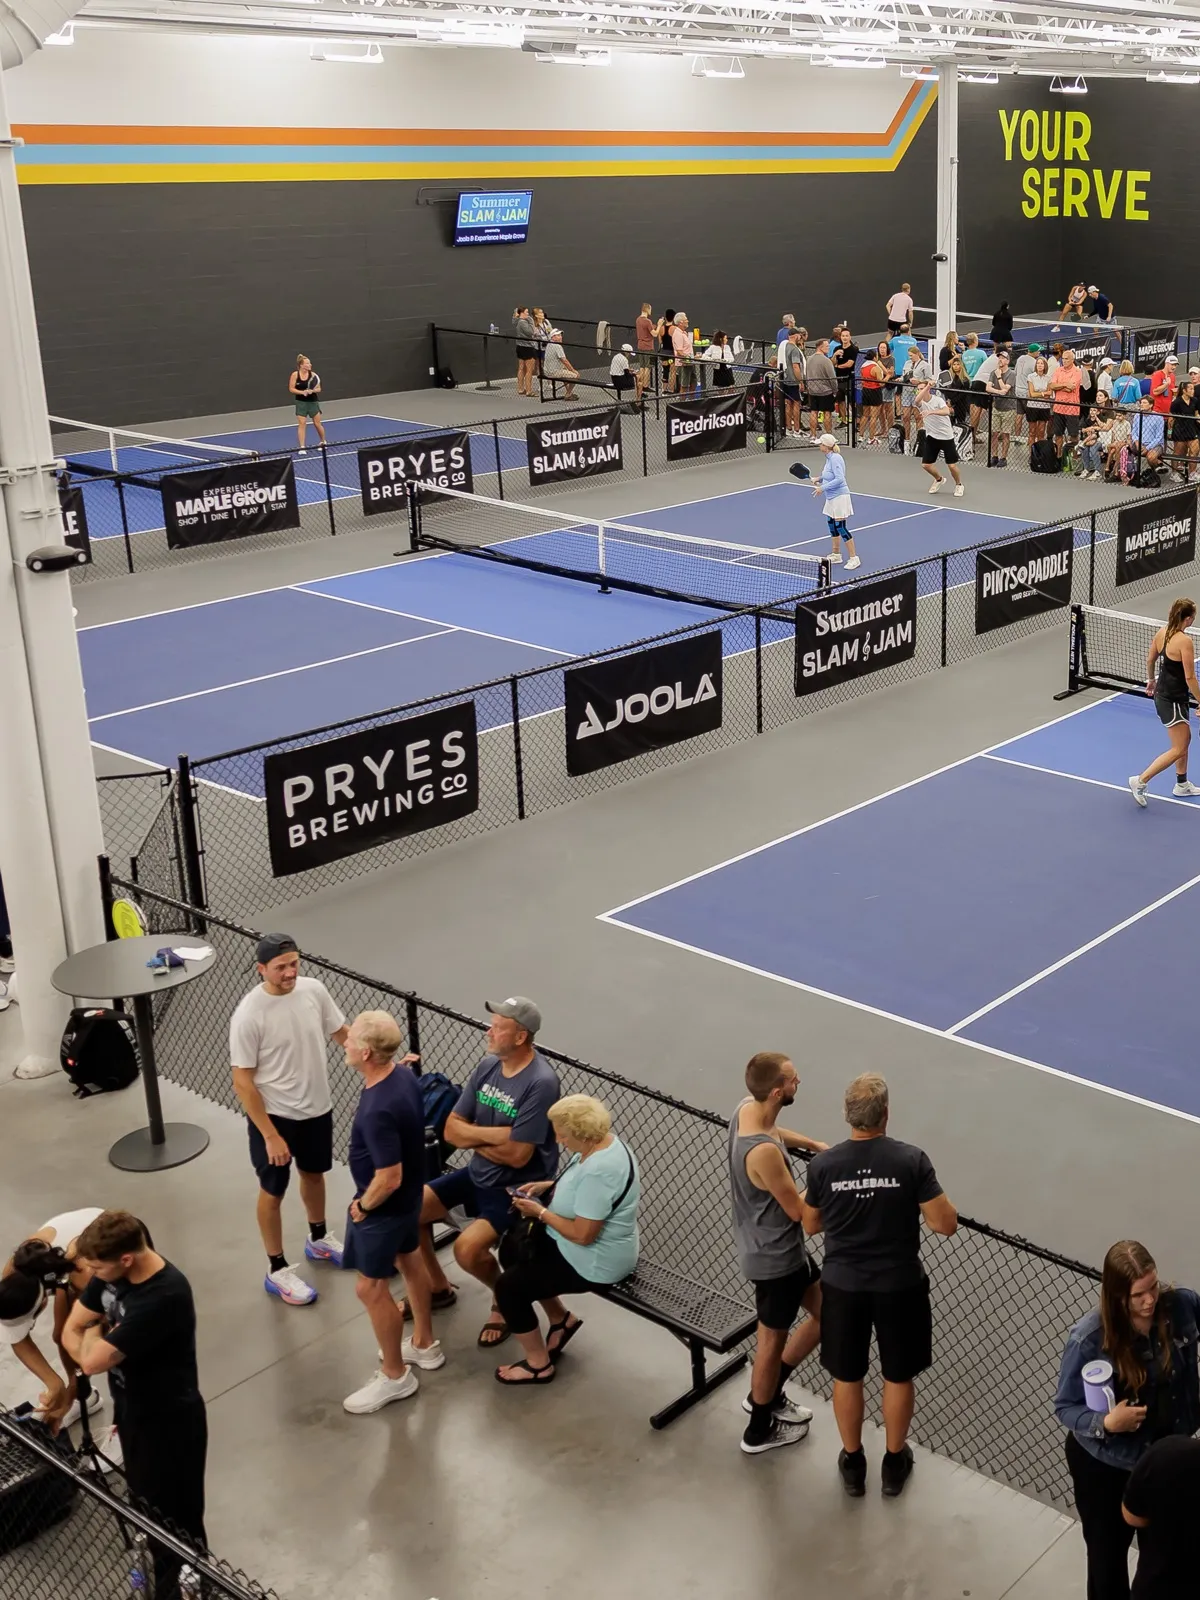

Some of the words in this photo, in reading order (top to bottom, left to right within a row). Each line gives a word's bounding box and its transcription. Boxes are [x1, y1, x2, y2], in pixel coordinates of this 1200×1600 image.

[998, 109, 1092, 161] YOUR
[471, 196, 521, 209] Summer
[1021, 167, 1151, 221] SERVE
[460, 209, 495, 223] SLAM
[501, 208, 527, 222] JAM
[1138, 344, 1157, 356] MAPLE
[1156, 341, 1176, 353] GROVE
[541, 423, 609, 448] Summer
[670, 412, 744, 436] Fredrikson
[367, 446, 465, 484] PRYES
[533, 450, 576, 474] SLAM
[587, 443, 619, 465] JAM
[203, 482, 259, 497] EXPERIENCE
[451, 471, 466, 481] CO
[175, 494, 233, 517] MAPLE
[232, 484, 287, 507] GROVE
[178, 517, 199, 527] SHOP
[211, 511, 229, 521] DINE
[241, 506, 259, 516] PLAY
[271, 502, 287, 511] STAY
[1125, 527, 1159, 553] MAPLE
[1159, 517, 1192, 541] GROVE
[1143, 515, 1176, 531] EXPERIENCE
[1162, 540, 1174, 550] PLAY
[982, 565, 1018, 599] PINTS
[1027, 550, 1070, 585] PADDLE
[815, 593, 904, 637] Summer
[802, 638, 860, 678] SLAM
[873, 620, 912, 655] JAM
[605, 673, 717, 732] JOOLA
[283, 730, 466, 818] PRYES
[288, 783, 435, 848] BREWING
[440, 773, 468, 792] CO
[831, 1177, 900, 1192] PICKLEBALL
